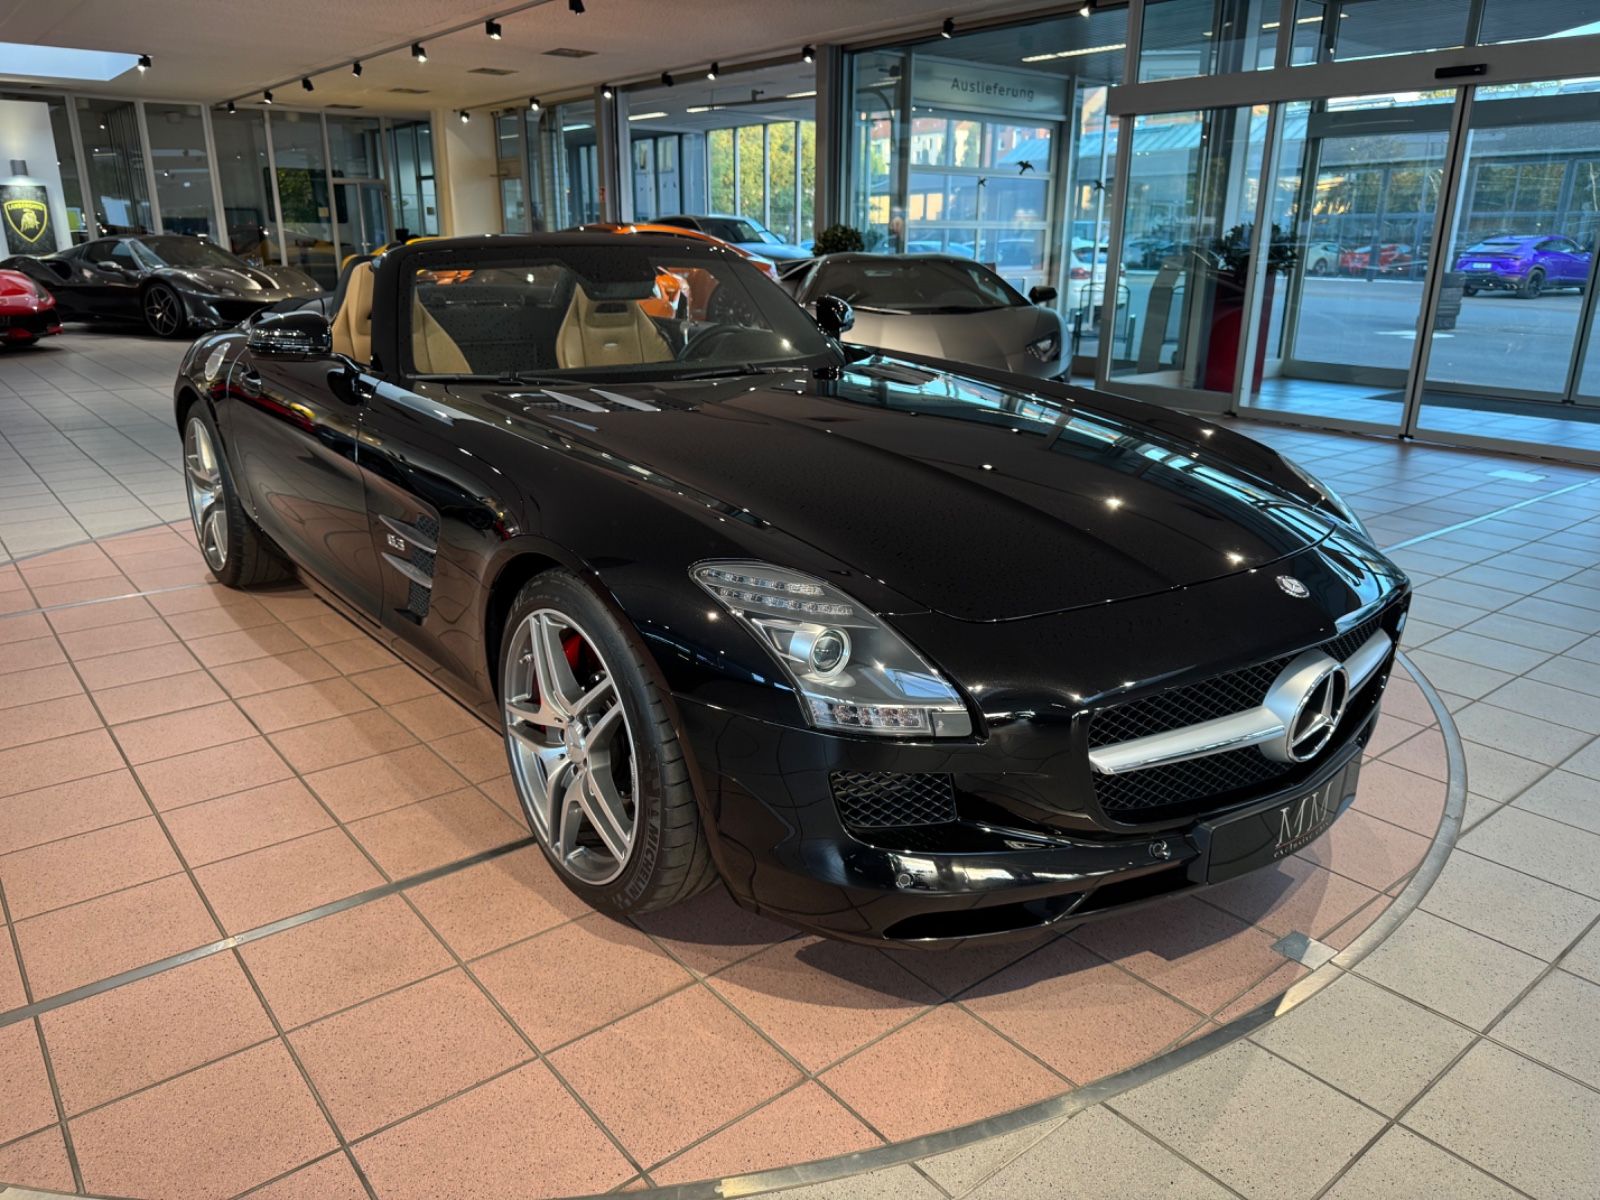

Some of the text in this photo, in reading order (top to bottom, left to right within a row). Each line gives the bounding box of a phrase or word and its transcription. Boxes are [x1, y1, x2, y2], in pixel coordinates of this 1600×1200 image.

[951, 77, 1034, 102] Auslieferung
[1275, 781, 1333, 850] MM
[625, 821, 660, 900] MICHELIN
